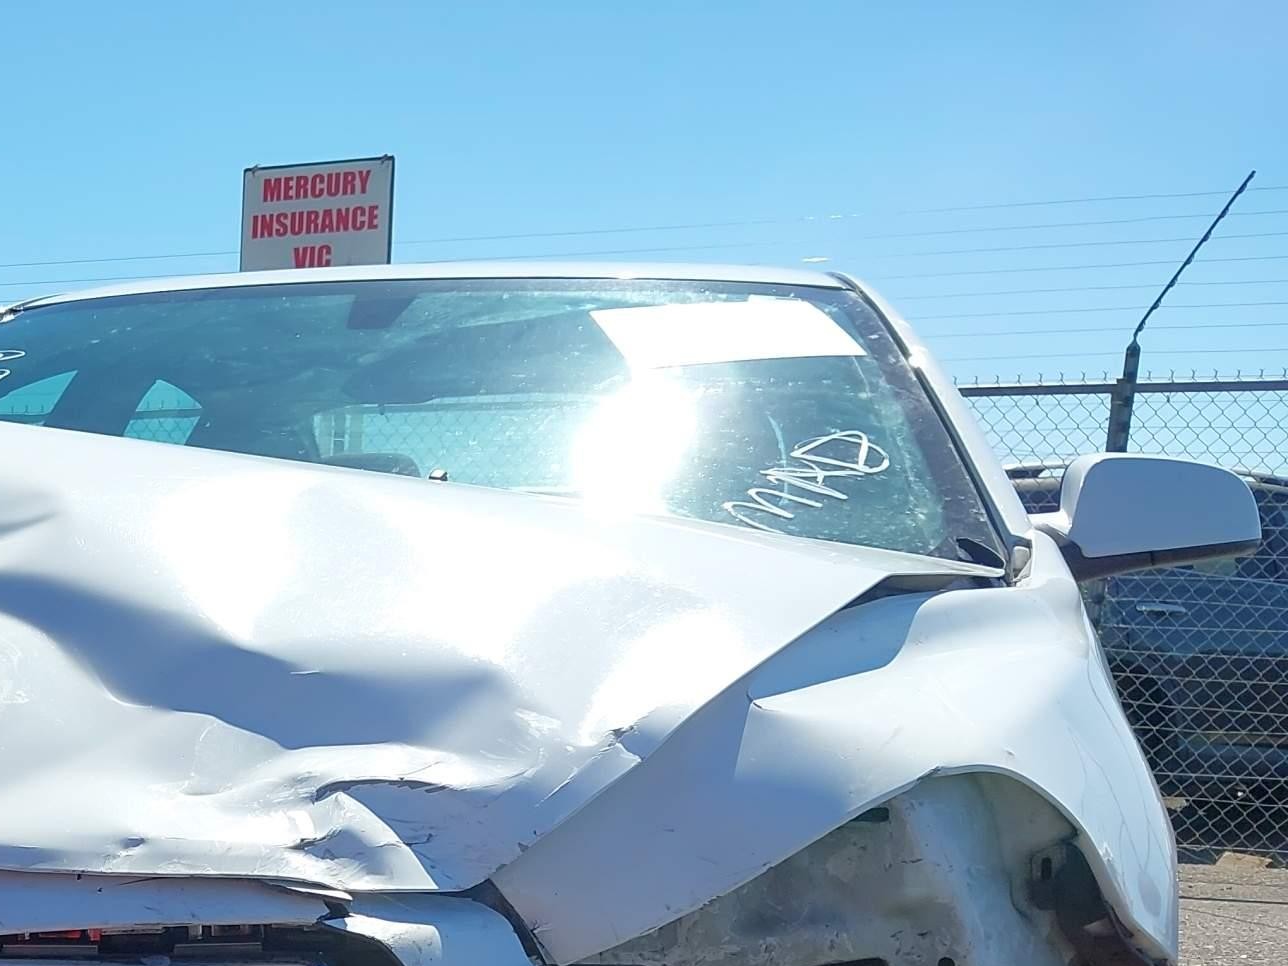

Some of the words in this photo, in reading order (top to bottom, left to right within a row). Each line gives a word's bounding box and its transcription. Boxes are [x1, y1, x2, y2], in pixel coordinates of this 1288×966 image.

[263, 169, 372, 202] MERCURY
[251, 205, 379, 239] INSURANCE
[293, 244, 333, 269] VIC
